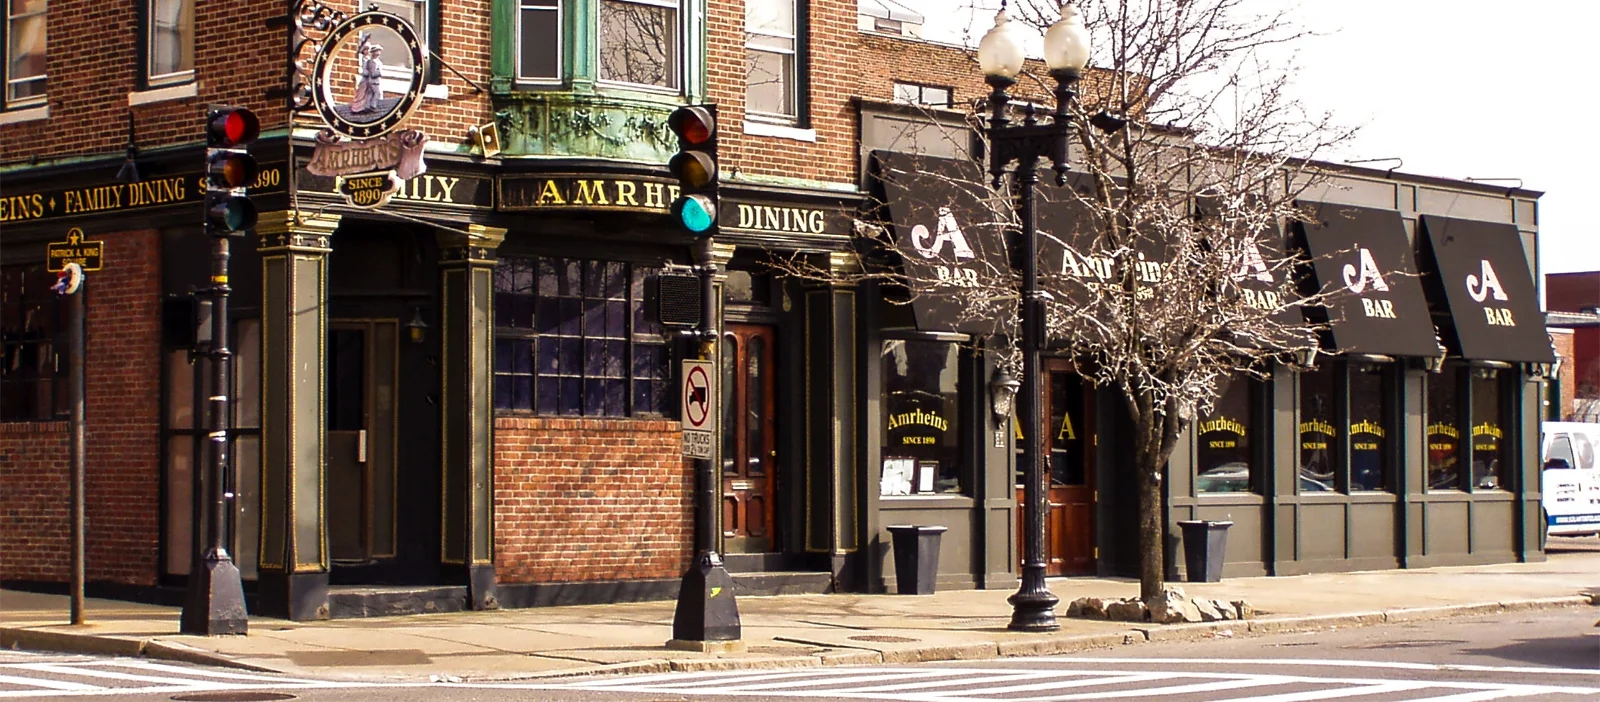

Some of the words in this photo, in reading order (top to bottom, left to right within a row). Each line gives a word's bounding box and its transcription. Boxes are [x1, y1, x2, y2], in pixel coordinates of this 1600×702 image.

[312, 139, 400, 171] AMRHEINS
[333, 175, 459, 202] ILY
[349, 177, 383, 191] SINCE
[65, 185, 124, 213] FAMILY
[129, 177, 185, 207] DINING
[354, 188, 381, 203] 1890
[738, 204, 824, 233] DINING
[911, 207, 975, 258] A
[84, 247, 99, 256] KING
[937, 265, 980, 287] BAR
[1343, 248, 1389, 293] A
[1466, 260, 1508, 302] A
[1243, 288, 1281, 310] BAR
[1361, 297, 1396, 318] BAR
[1483, 307, 1516, 327] BAR
[888, 408, 949, 432] Amrheins
[1057, 411, 1076, 439] A
[1199, 416, 1246, 436] Amrheins
[1300, 418, 1336, 437] mrheins
[1349, 419, 1385, 438] mrheins
[1428, 421, 1459, 439] mrheins
[1472, 421, 1503, 439] mrheins
[683, 432, 690, 443] NO
[691, 432, 710, 445] TRUCKS
